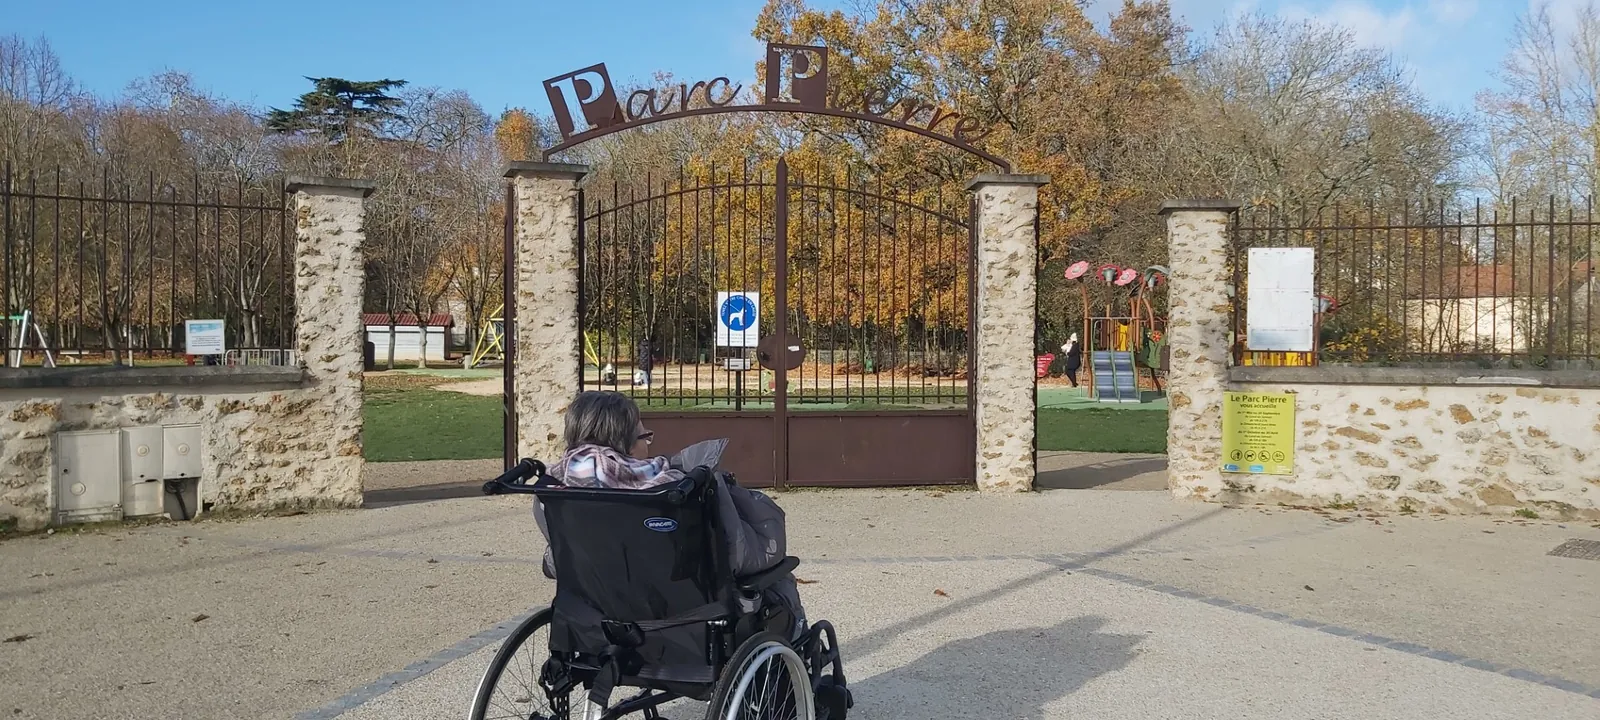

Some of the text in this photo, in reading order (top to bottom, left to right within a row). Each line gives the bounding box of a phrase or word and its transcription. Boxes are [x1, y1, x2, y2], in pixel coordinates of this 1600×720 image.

[546, 46, 993, 144] Parc Pierre
[1231, 394, 1287, 404] Le Parc Pierre
